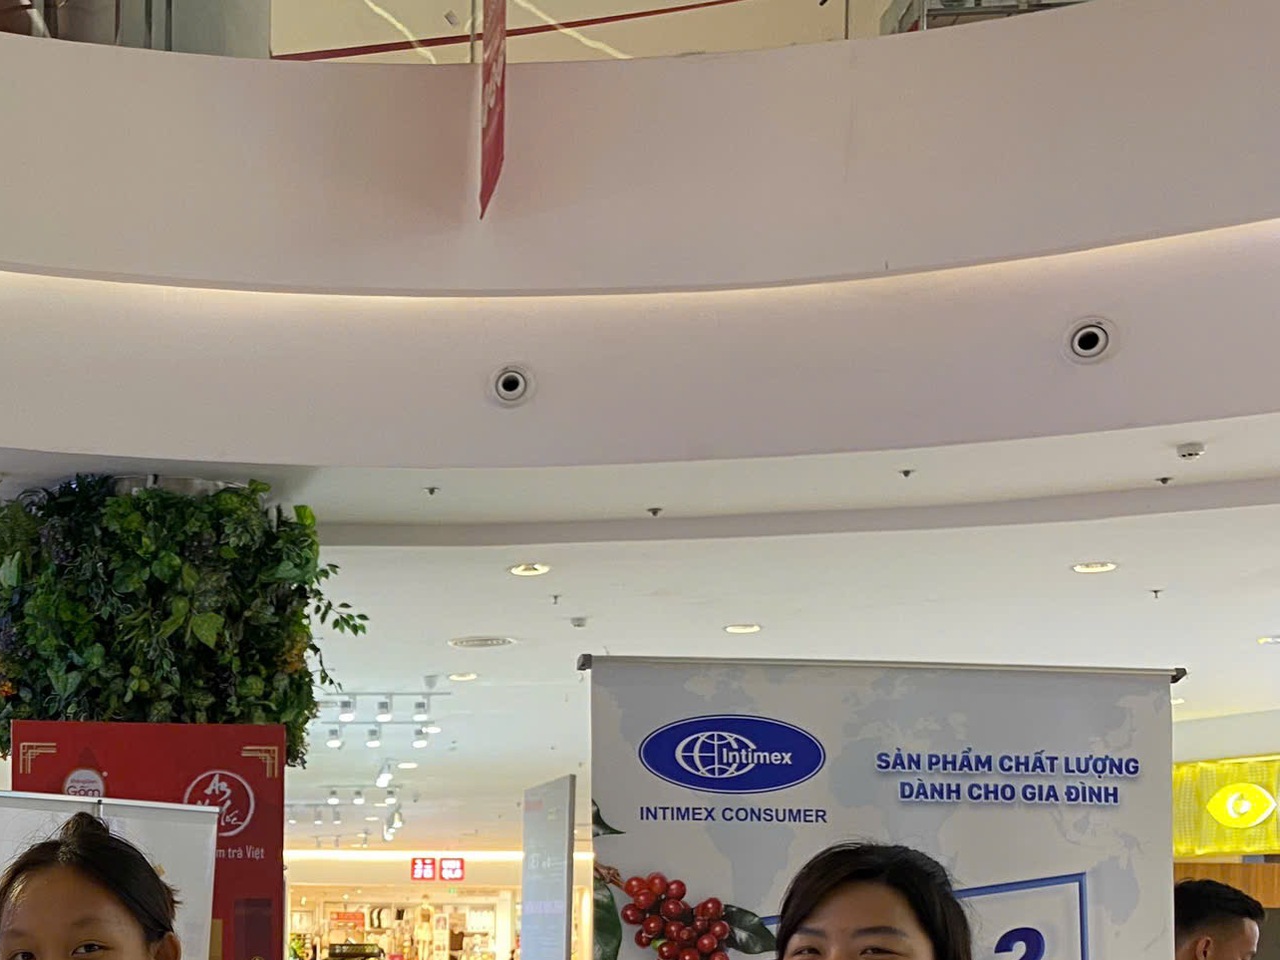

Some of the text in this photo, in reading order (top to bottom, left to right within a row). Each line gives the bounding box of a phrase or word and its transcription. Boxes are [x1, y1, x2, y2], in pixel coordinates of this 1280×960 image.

[723, 748, 792, 765] Intimex
[877, 747, 1140, 779] SẢN PHẨM CHẤT LƯỢNG
[899, 778, 1119, 804] DÀNH CHO GIA ĐÌNH
[640, 806, 827, 823] INTIMEX CONSUMER
